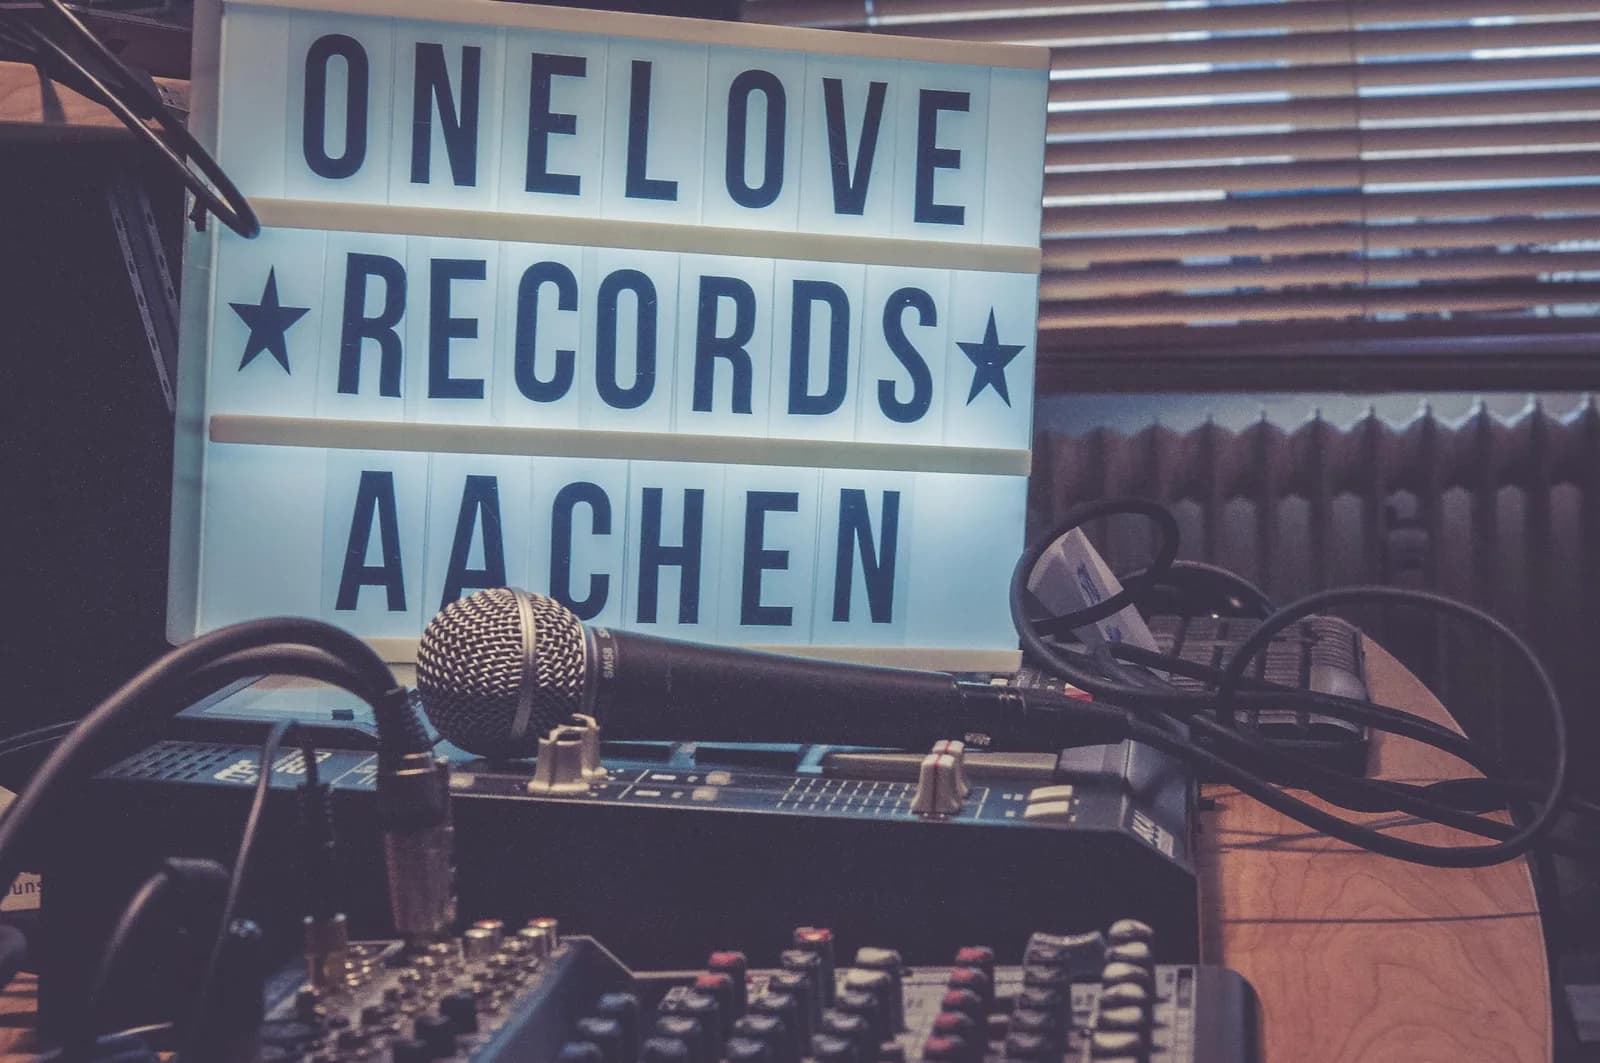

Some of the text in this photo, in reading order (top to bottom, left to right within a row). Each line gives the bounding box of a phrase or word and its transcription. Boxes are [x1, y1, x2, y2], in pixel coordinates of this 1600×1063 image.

[303, 33, 970, 226] ONELOVE
[338, 252, 937, 423] RECORDS
[335, 470, 900, 626] AACHEN
